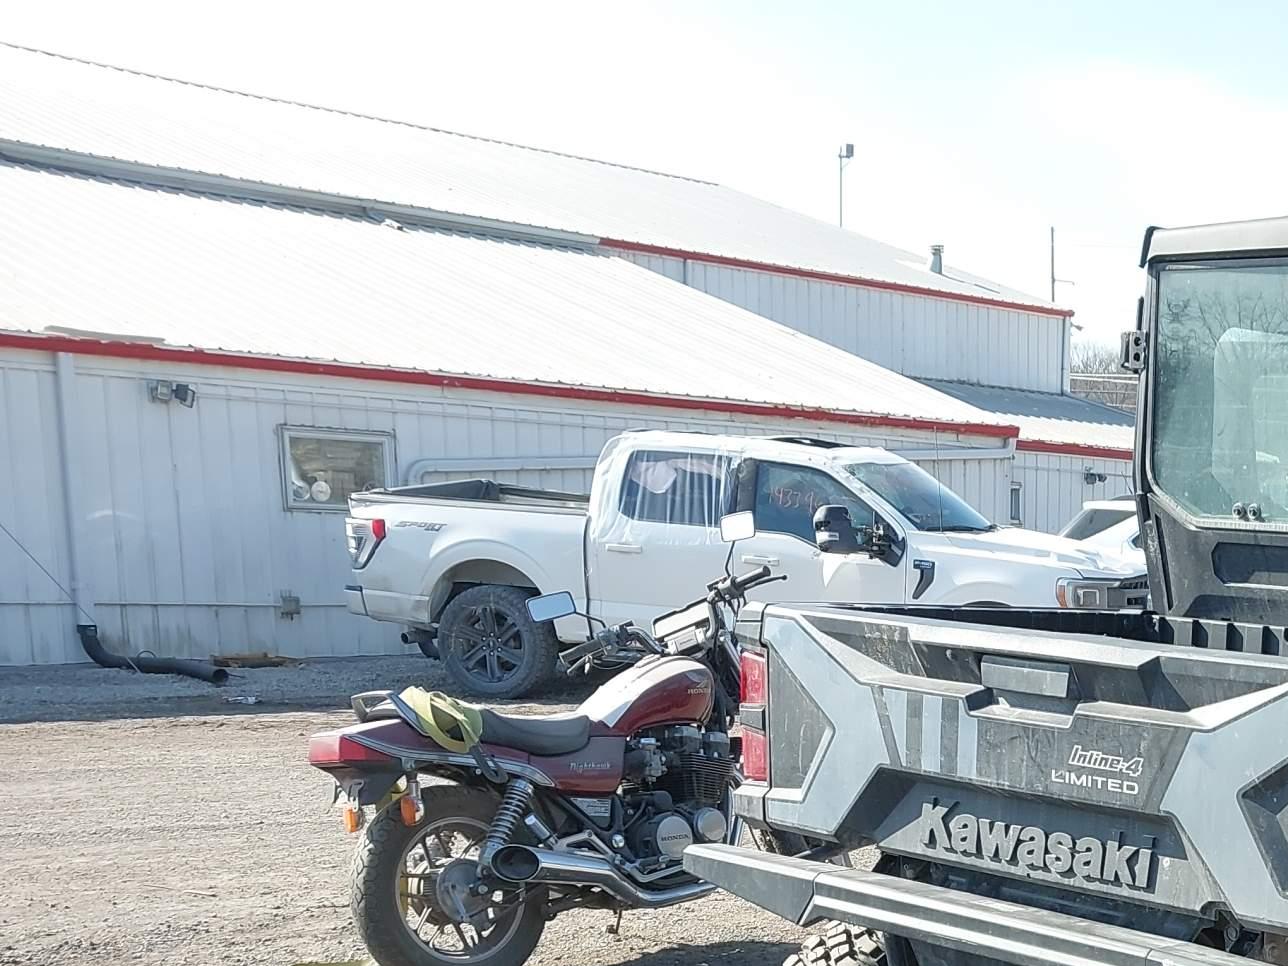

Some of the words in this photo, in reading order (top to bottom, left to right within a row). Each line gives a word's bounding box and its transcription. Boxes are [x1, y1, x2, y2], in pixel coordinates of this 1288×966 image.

[394, 520, 448, 532] SPORT
[1051, 768, 1139, 795] LIMITED
[660, 833, 689, 842] HONDA
[921, 801, 1156, 890] Kawasaki
